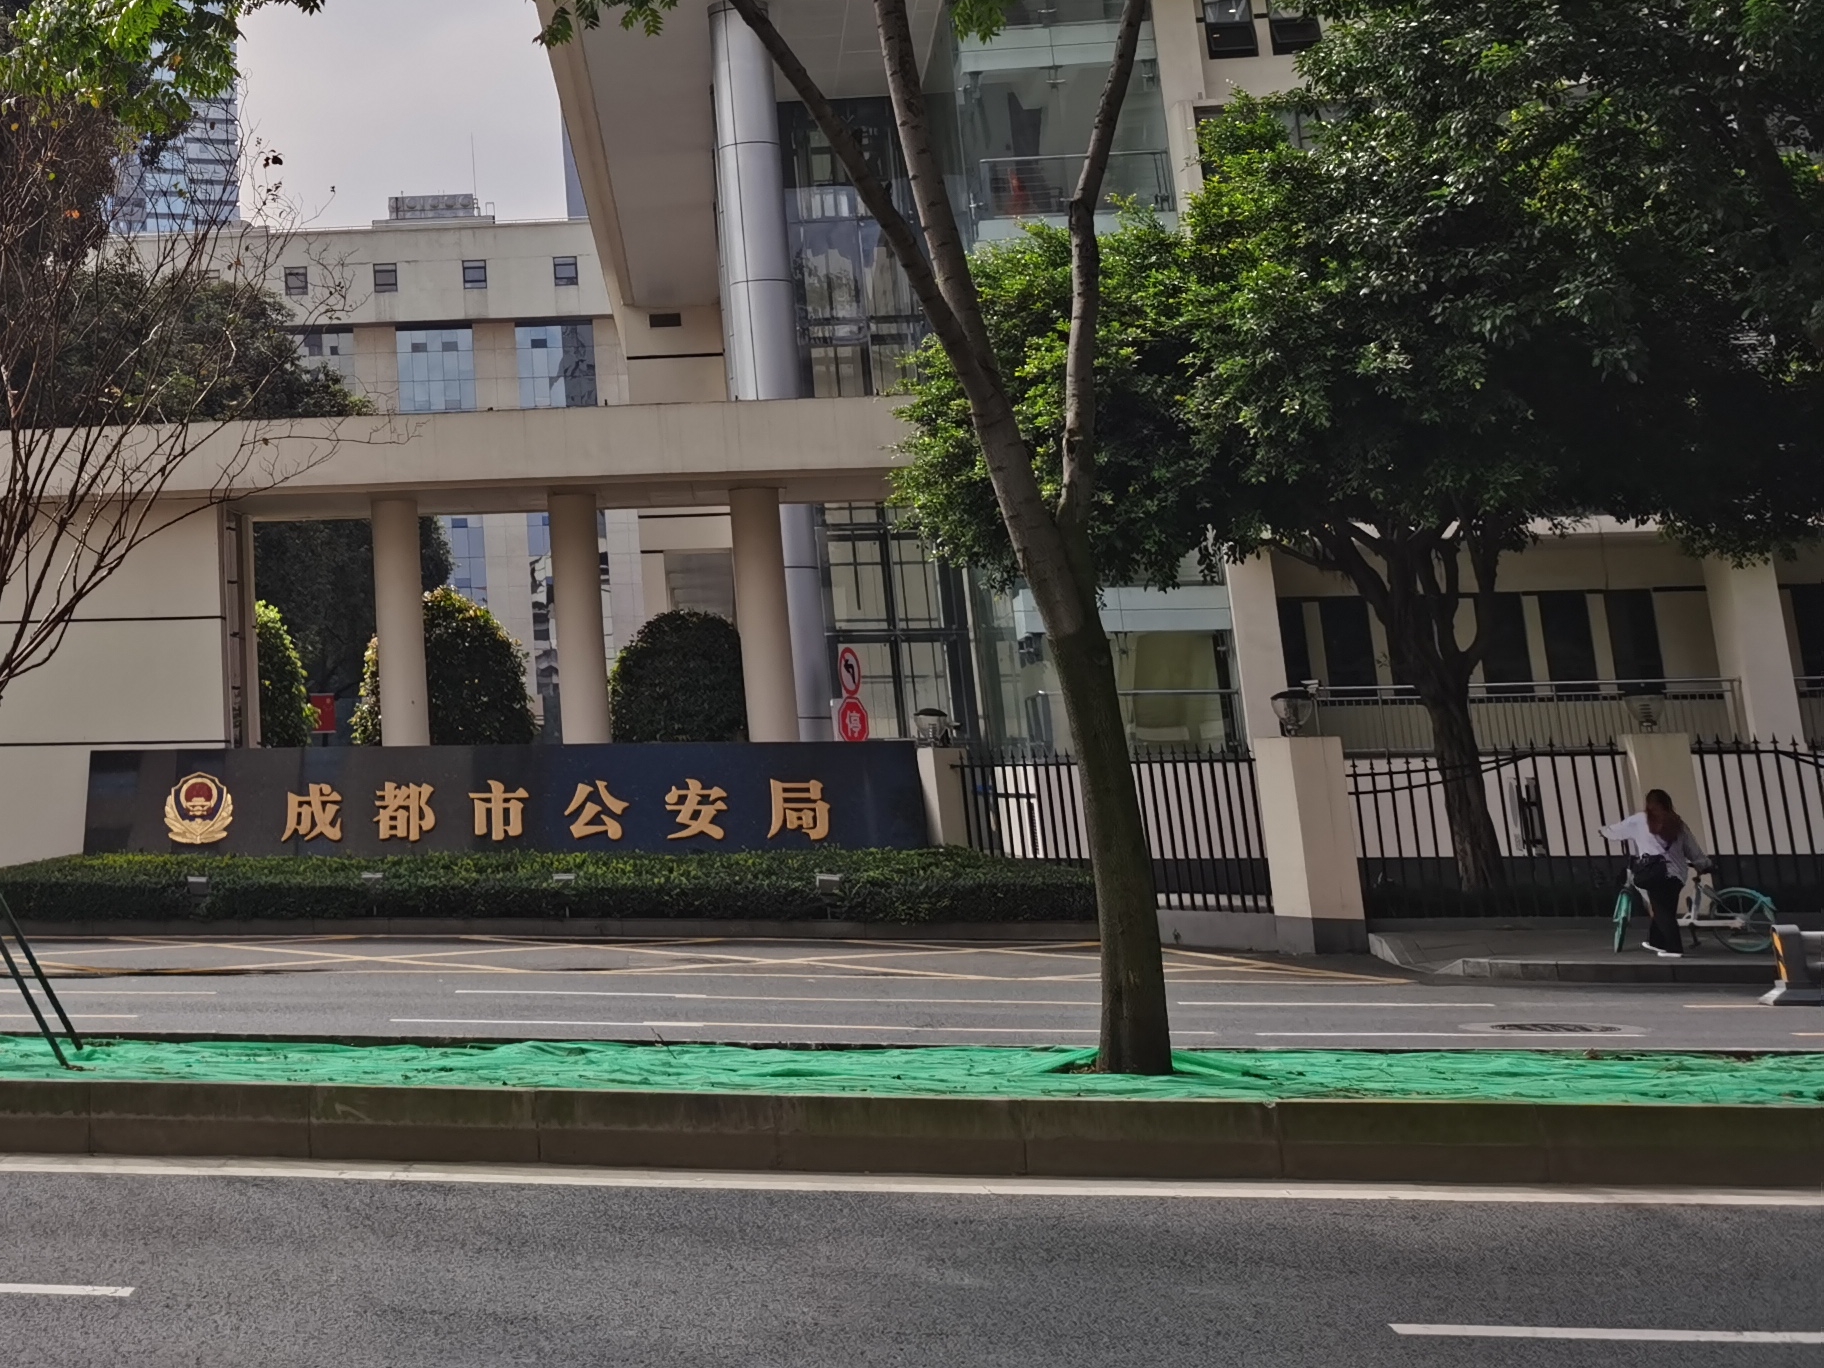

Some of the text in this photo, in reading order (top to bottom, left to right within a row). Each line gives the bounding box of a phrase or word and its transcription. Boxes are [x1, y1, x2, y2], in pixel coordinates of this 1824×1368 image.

[845, 710, 862, 738] 停
[281, 778, 832, 842] 成都市公安局
